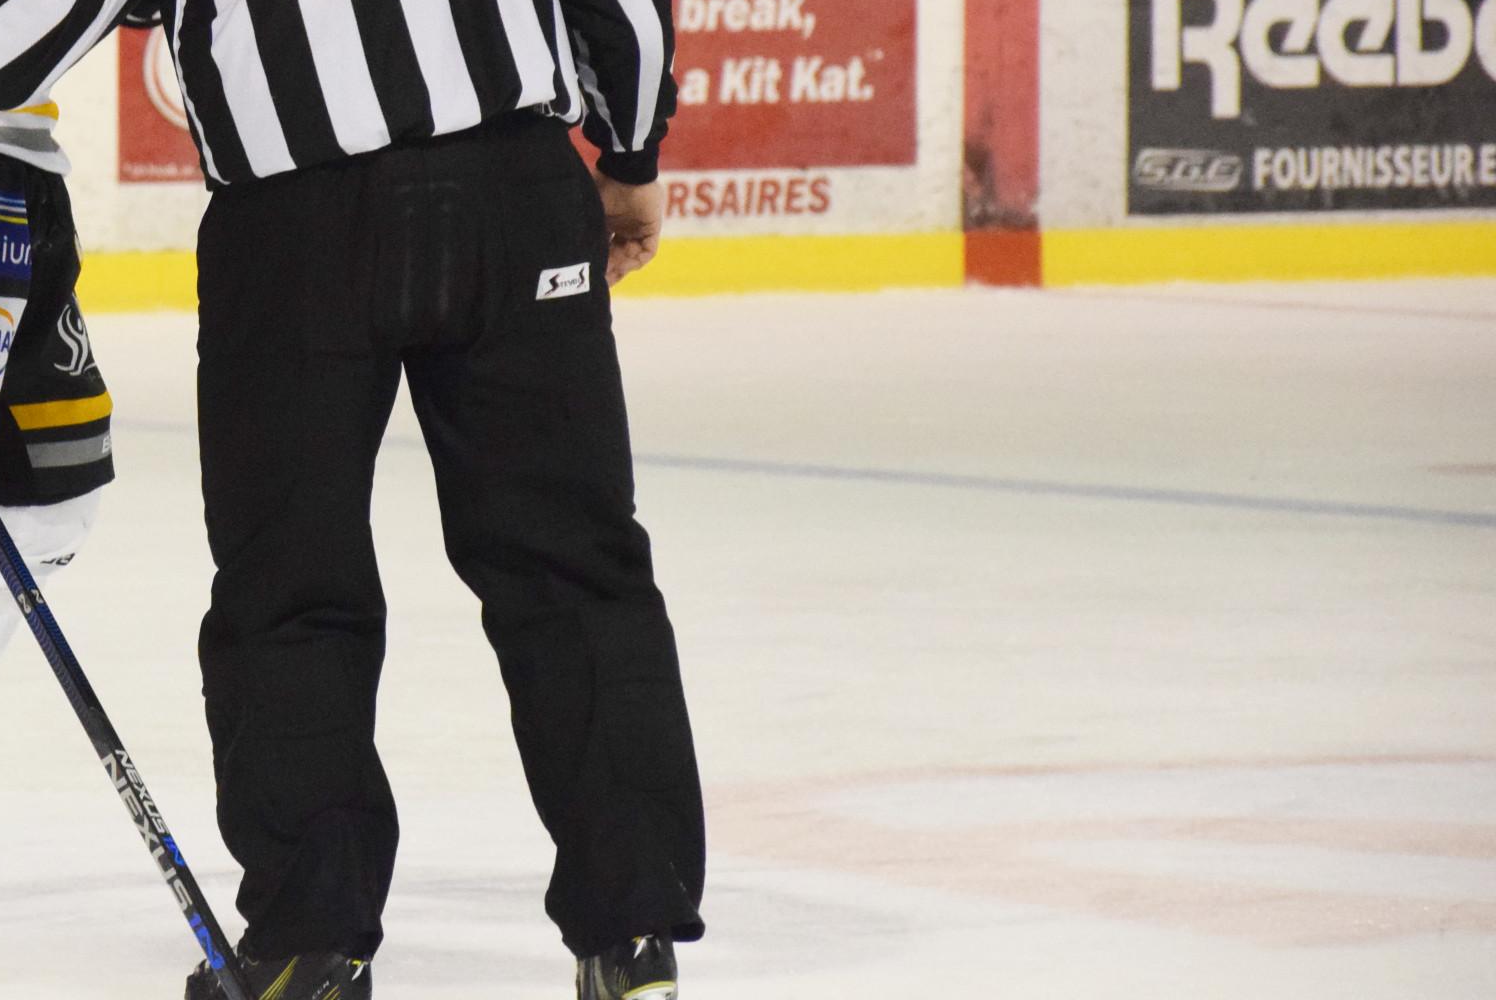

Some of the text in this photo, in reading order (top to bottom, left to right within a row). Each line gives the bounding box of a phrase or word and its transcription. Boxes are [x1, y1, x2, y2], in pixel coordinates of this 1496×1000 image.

[679, 68, 710, 104] a
[719, 56, 783, 103] Kit
[1254, 145, 1475, 188] FOURNISSEUR
[665, 176, 832, 217] RSAIRES
[115, 749, 169, 834] NEXUS
[103, 753, 193, 911] NEXUS
